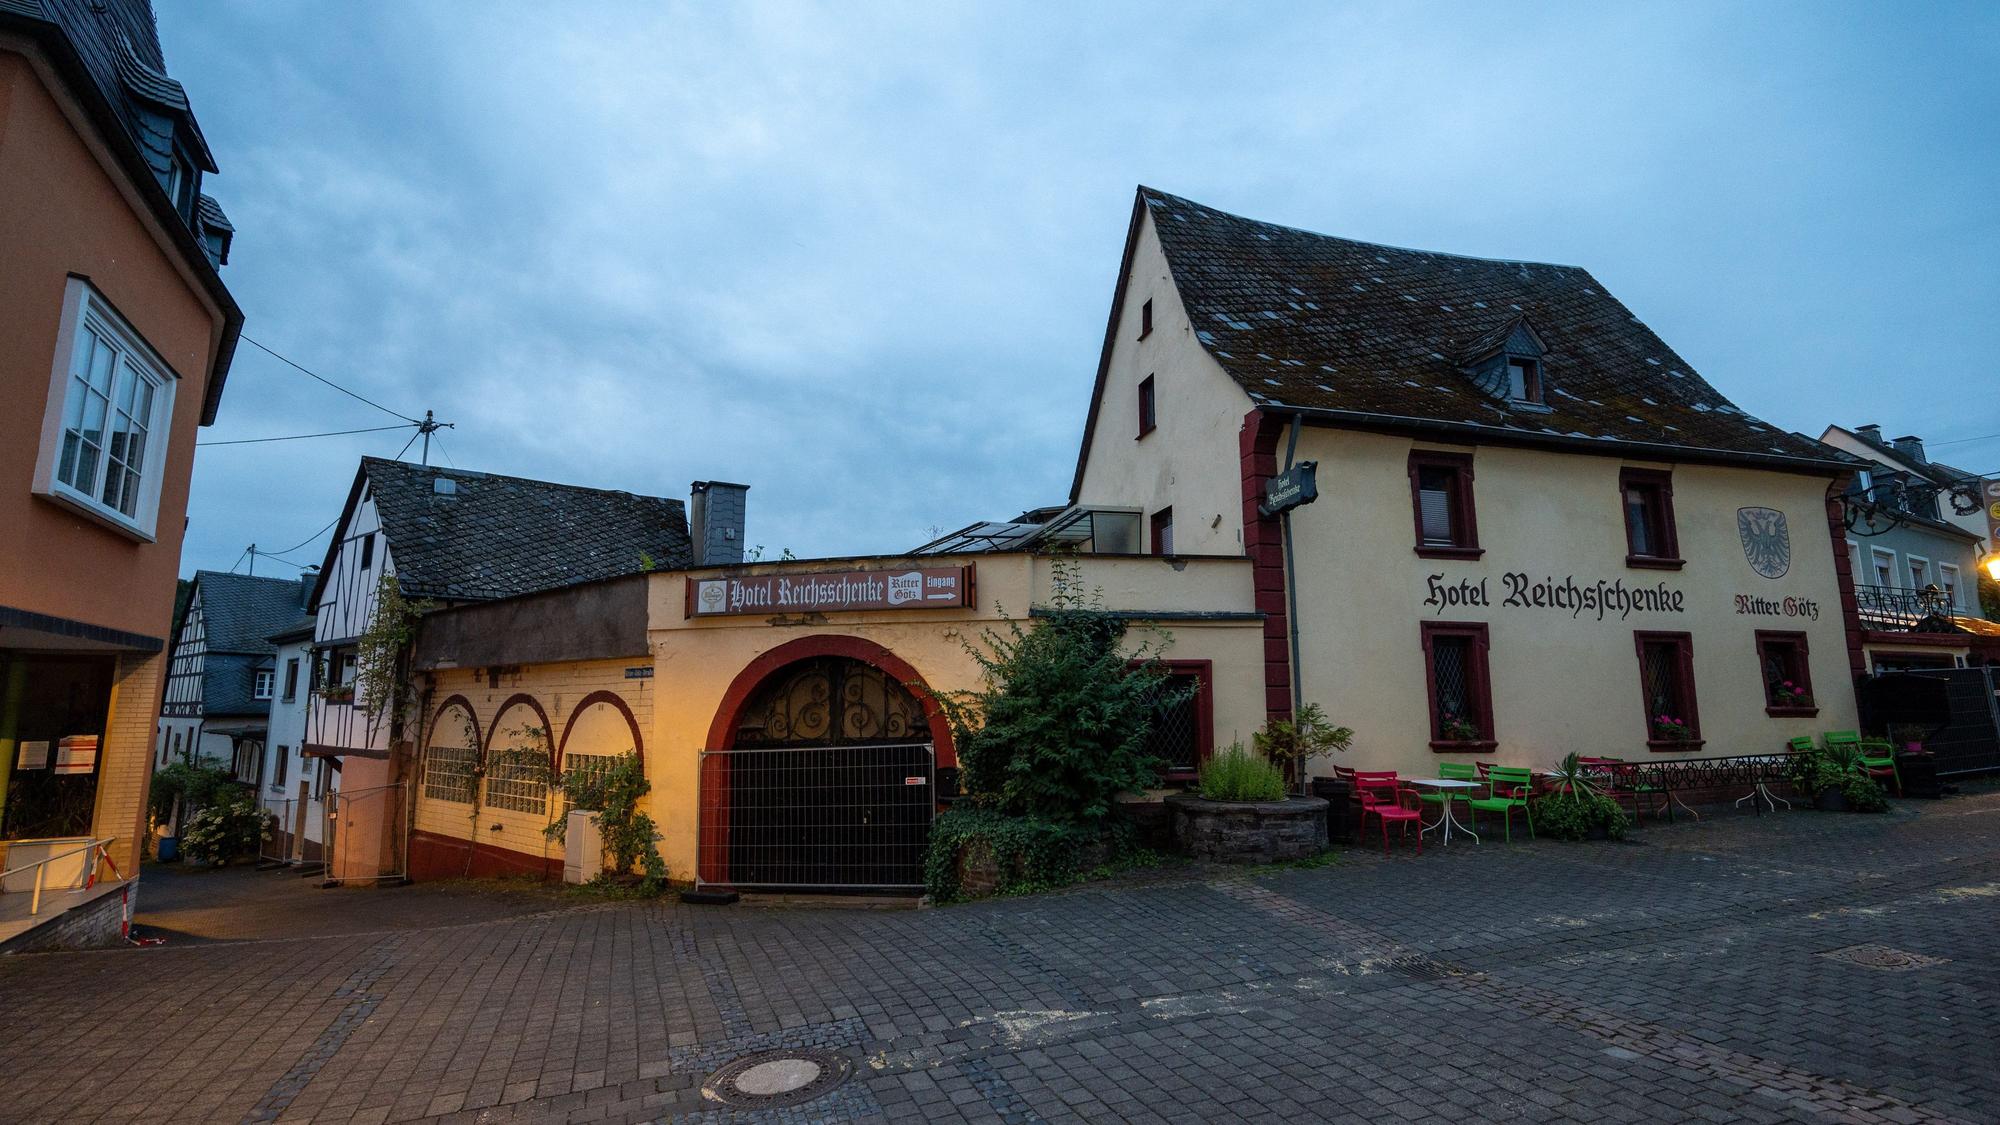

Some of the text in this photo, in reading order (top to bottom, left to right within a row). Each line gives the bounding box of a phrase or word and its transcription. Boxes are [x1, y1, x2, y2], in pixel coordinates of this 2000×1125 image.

[891, 578, 919, 588] Ritter
[927, 576, 955, 588] Eingang
[731, 576, 884, 612] Hotel Reichsschenke
[894, 588, 917, 599] Götz
[1423, 573, 1490, 615] Hotel
[1735, 594, 1819, 622] Ritter Götz
